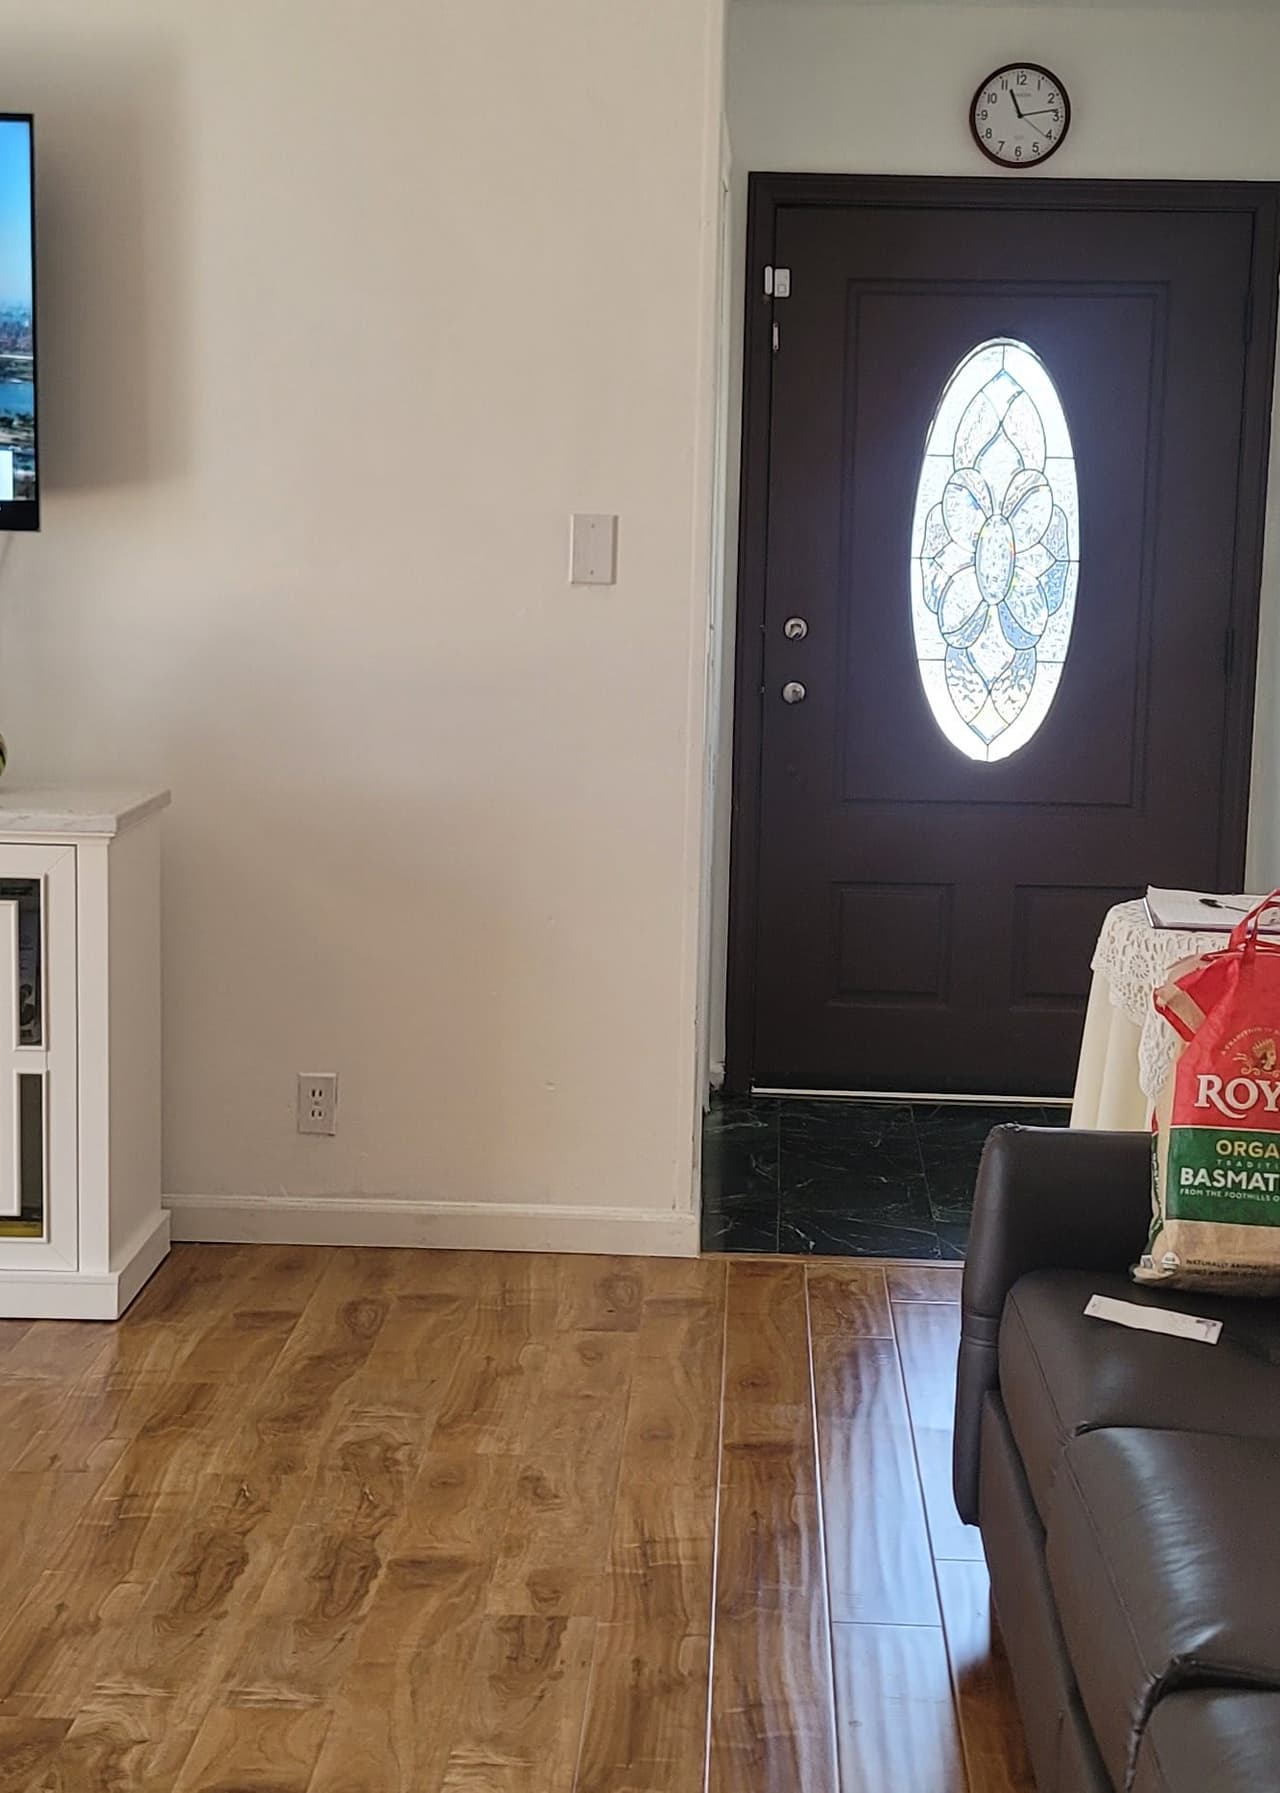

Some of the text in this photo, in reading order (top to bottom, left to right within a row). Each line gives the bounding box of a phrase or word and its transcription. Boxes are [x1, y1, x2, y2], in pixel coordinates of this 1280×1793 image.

[1016, 74, 1028, 86] 12
[987, 92, 998, 104] 10
[1047, 92, 1055, 104] 2
[980, 109, 989, 121] 9
[985, 127, 993, 139] 8
[1045, 129, 1053, 141] 4
[997, 141, 1006, 152] 7
[1014, 146, 1022, 157] 6
[1031, 142, 1040, 153] 5
[1180, 1188, 1203, 1196] FROM
[1205, 1189, 1222, 1197] THE
[1224, 1191, 1271, 1202] FOOTHILLS
